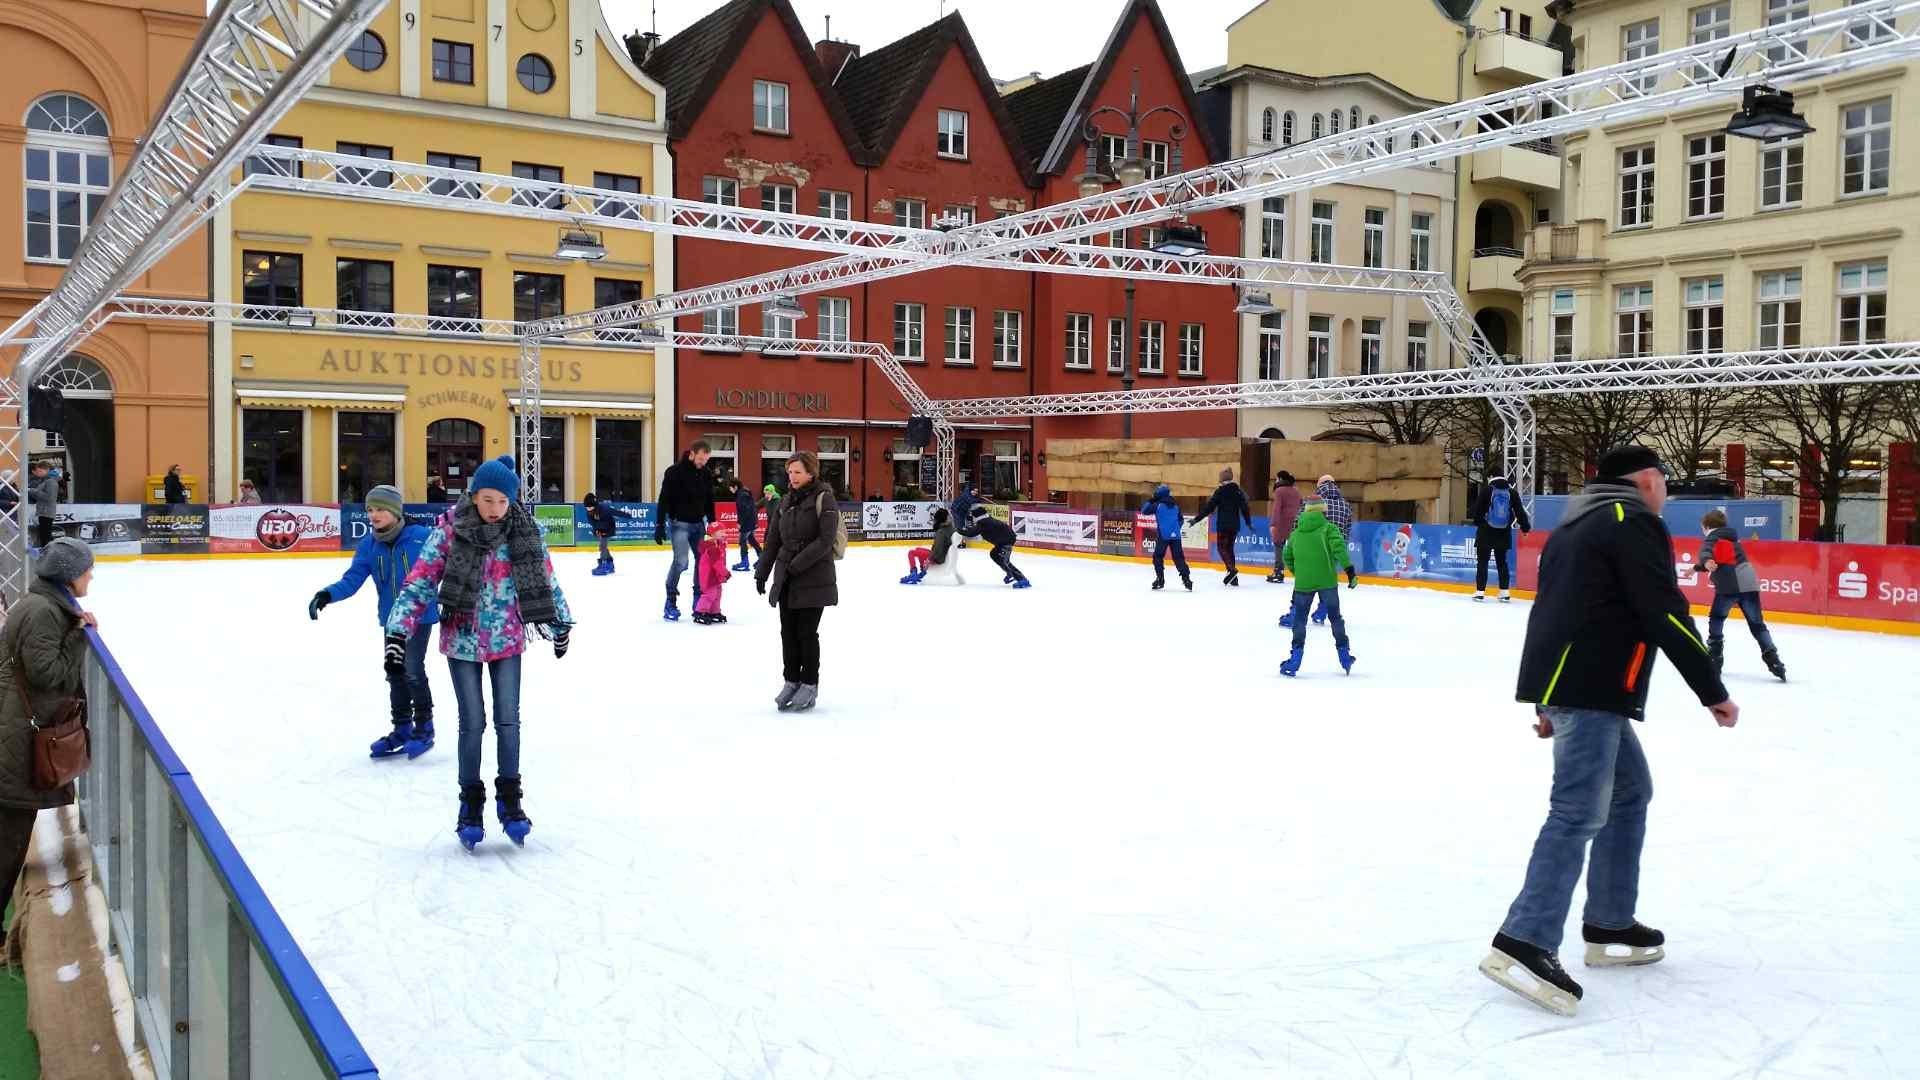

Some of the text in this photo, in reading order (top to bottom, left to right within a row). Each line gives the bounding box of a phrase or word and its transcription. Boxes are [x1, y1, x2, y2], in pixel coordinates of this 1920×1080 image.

[405, 13, 583, 57] 9 7 5
[319, 348, 583, 382] AUKTIONSHUS
[417, 389, 497, 411] SCHWERIN
[296, 513, 338, 538] Party
[1878, 581, 1919, 605] Spa
